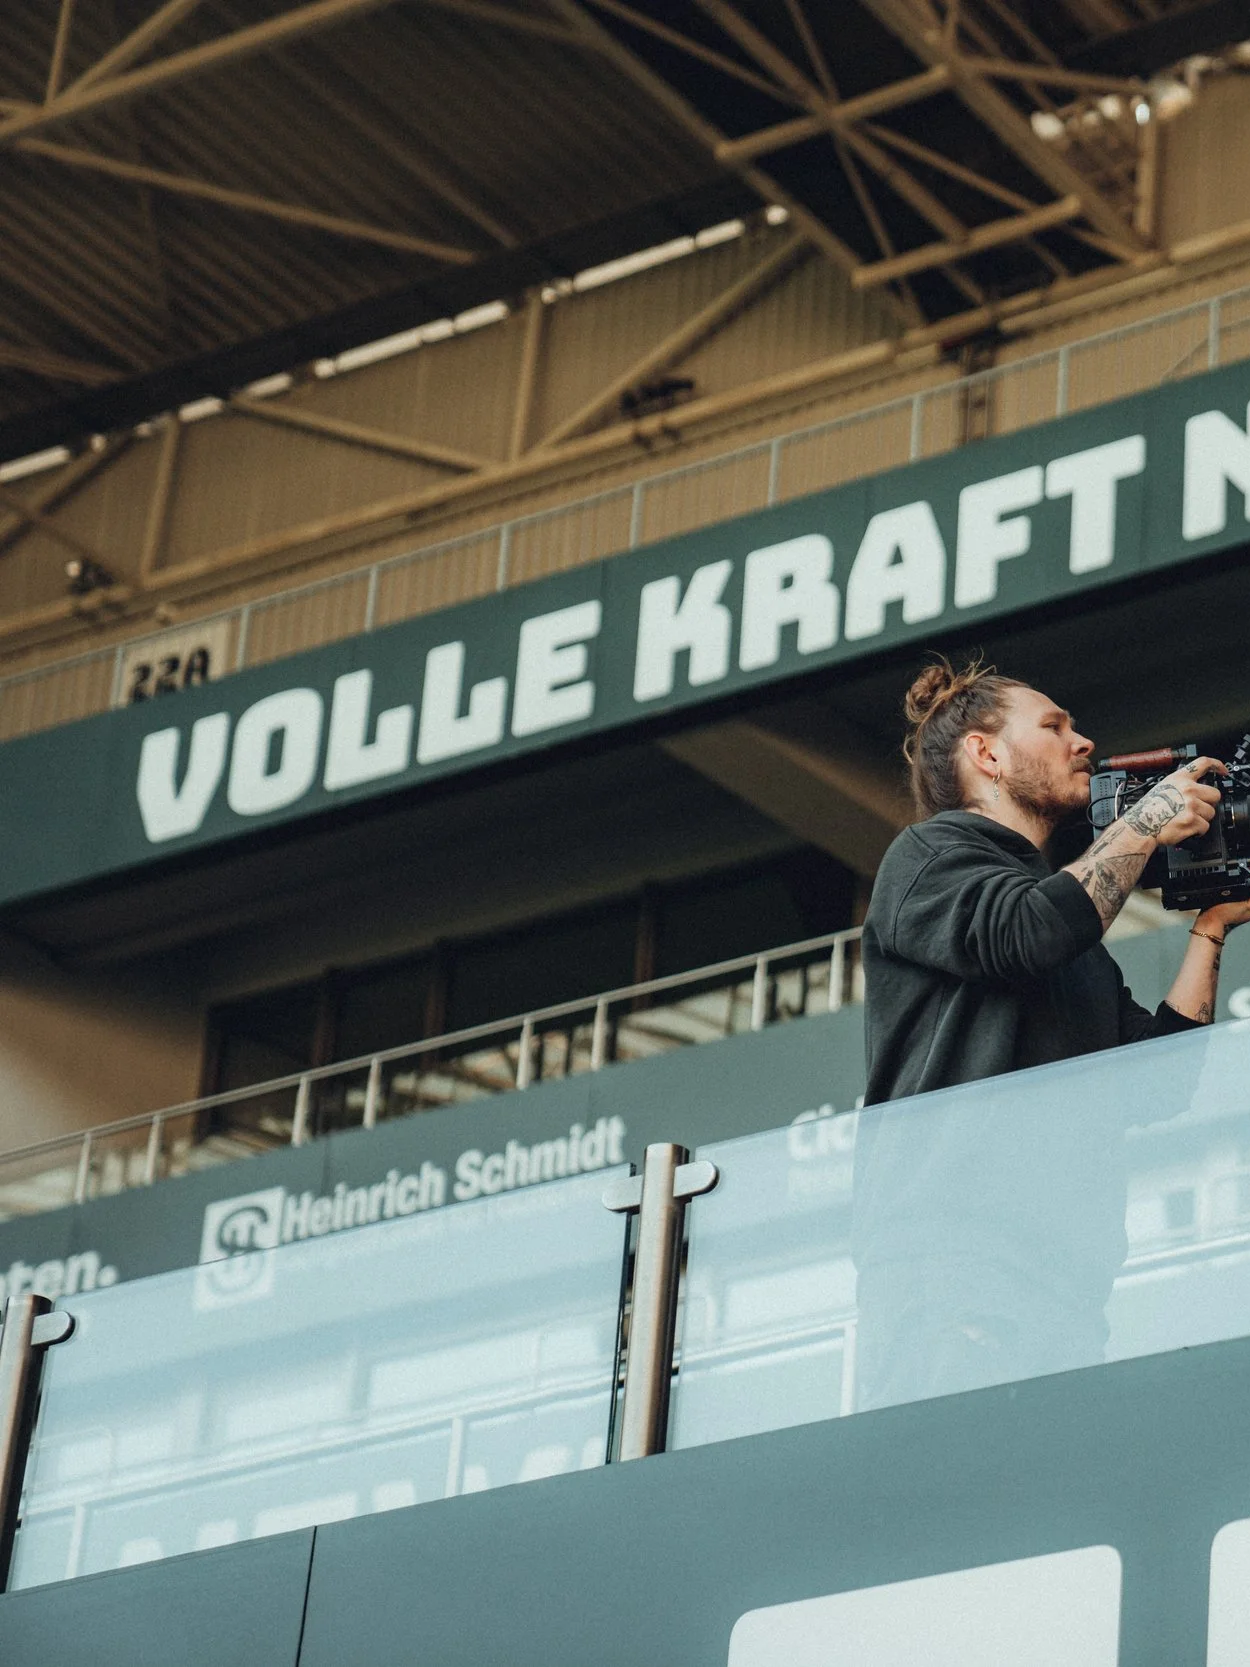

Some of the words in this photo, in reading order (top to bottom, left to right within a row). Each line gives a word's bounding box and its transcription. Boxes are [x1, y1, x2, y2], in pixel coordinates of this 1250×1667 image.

[137, 599, 603, 843] VOLLE
[632, 434, 1147, 702] KRAFT
[280, 1160, 447, 1245] Heinrich
[453, 1115, 628, 1201] Schmidt
[0, 1250, 120, 1298] ten.
